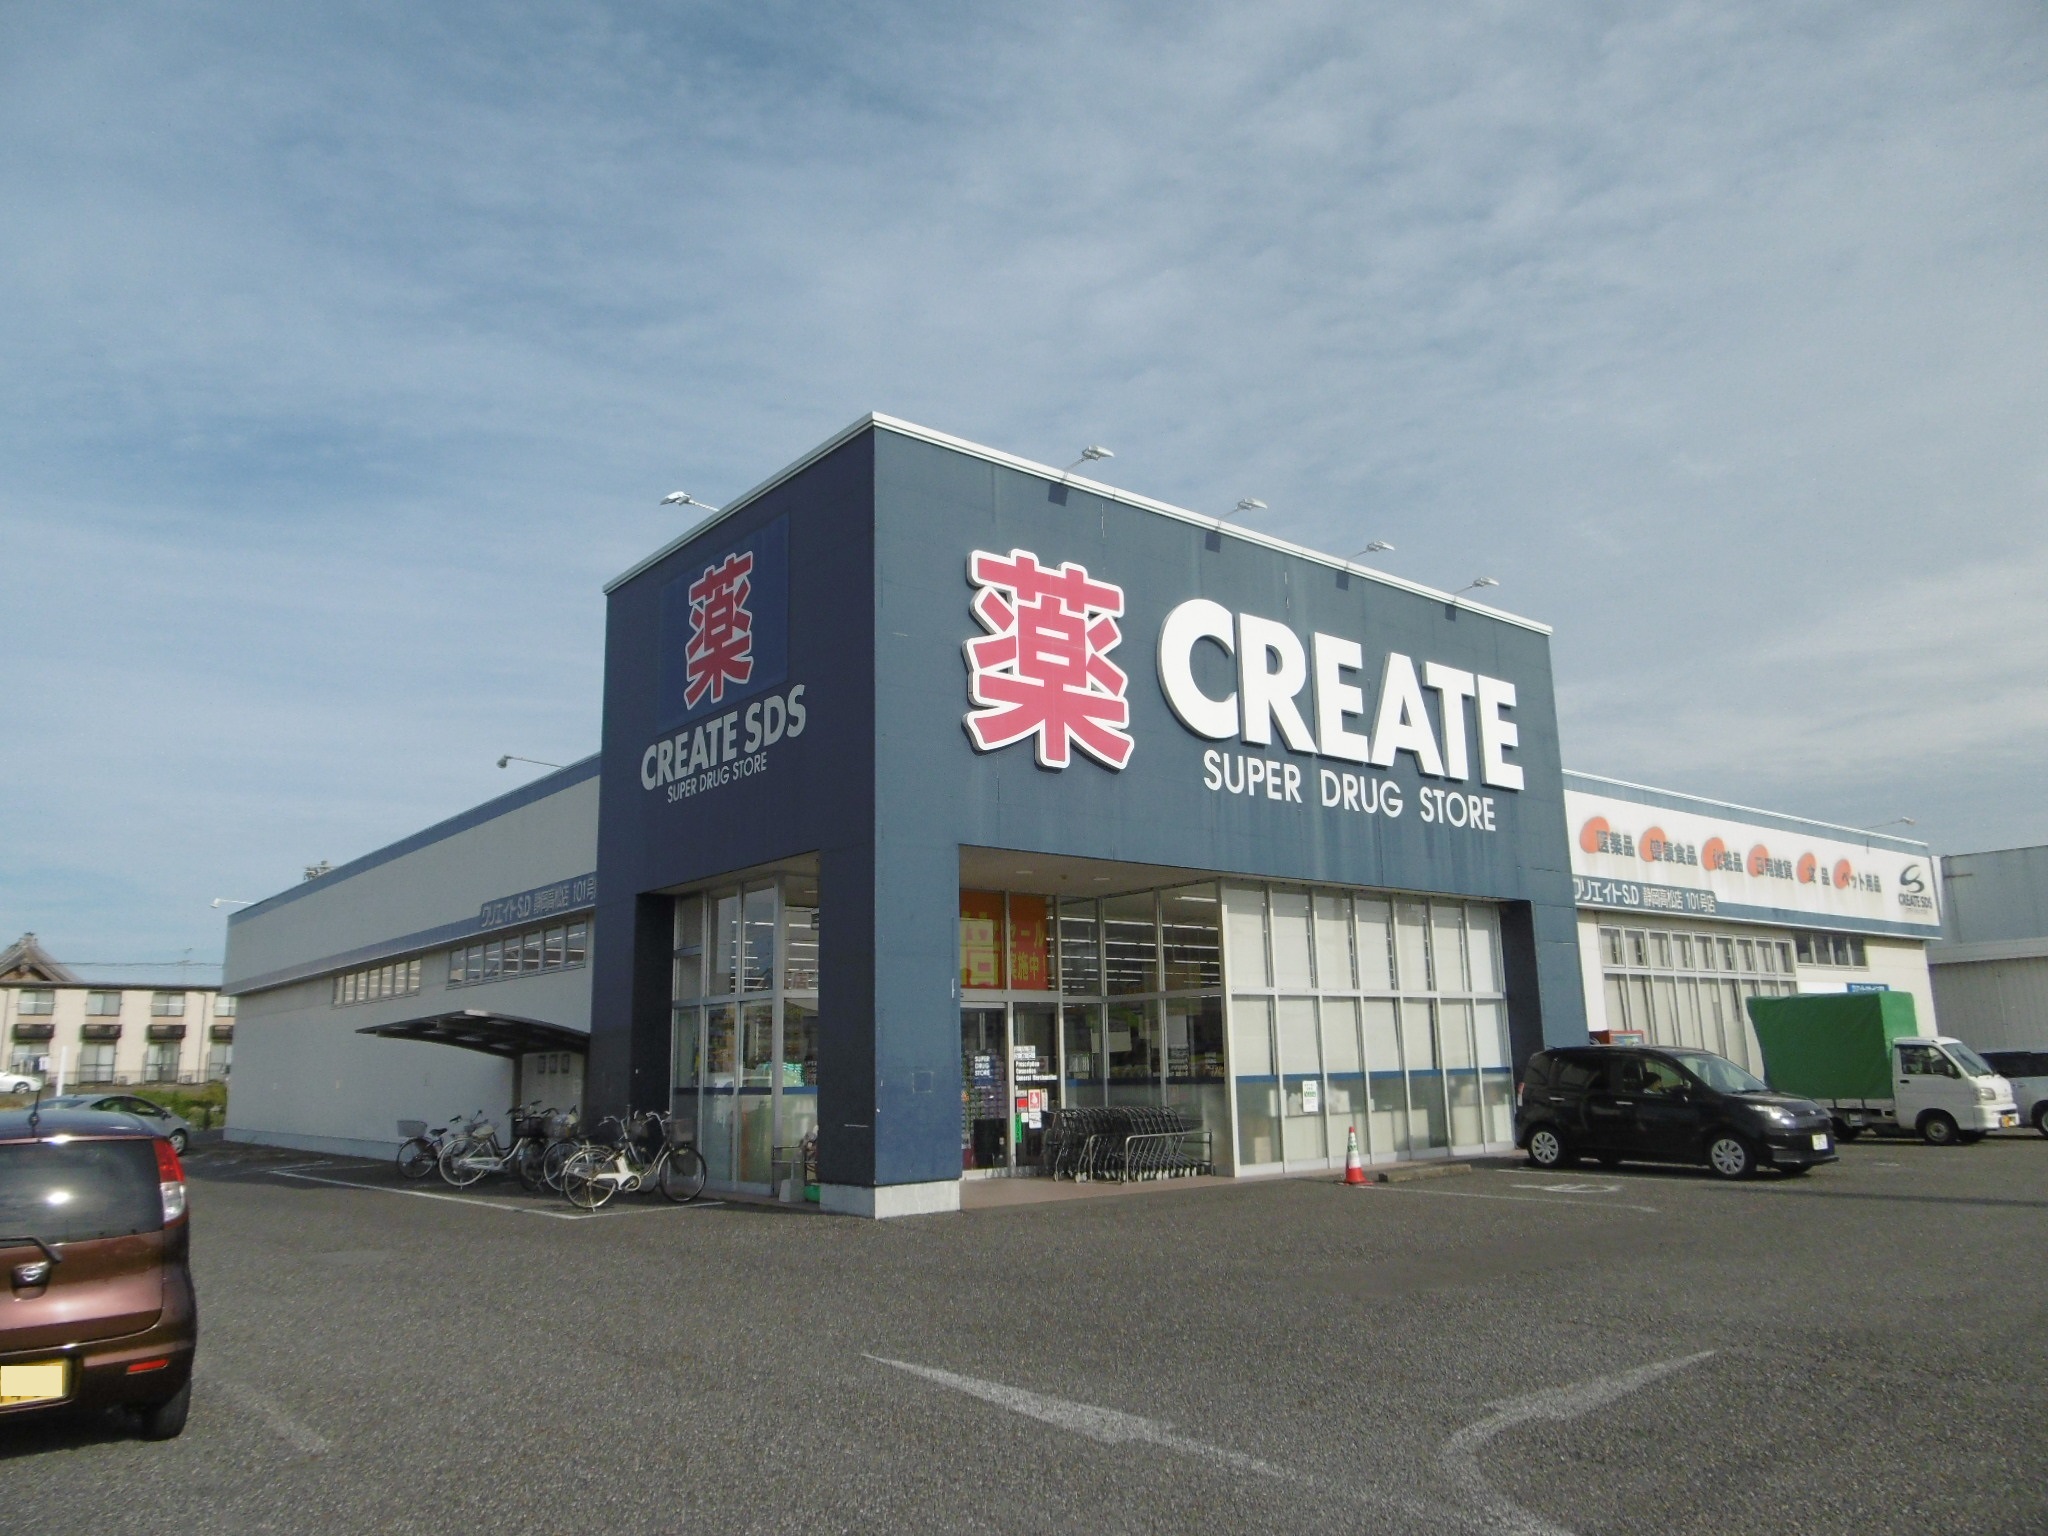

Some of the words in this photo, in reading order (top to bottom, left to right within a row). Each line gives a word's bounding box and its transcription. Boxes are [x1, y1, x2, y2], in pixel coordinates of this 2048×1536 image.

[683, 550, 754, 710] 薬
[963, 548, 1135, 771] 薬
[1158, 598, 1525, 791] CREATE
[640, 711, 738, 791] CREATE
[743, 683, 807, 753] SDS
[667, 776, 697, 803] SUPER
[700, 766, 730, 793] DRUG
[732, 751, 768, 782] STORE
[1203, 749, 1303, 803] SUPER
[1320, 768, 1403, 818] DRUG
[1420, 786, 1497, 832] STORE
[1597, 830, 1636, 858] 医薬品
[1650, 839, 1699, 867] 健康食品
[1713, 847, 1744, 873] 化粧品
